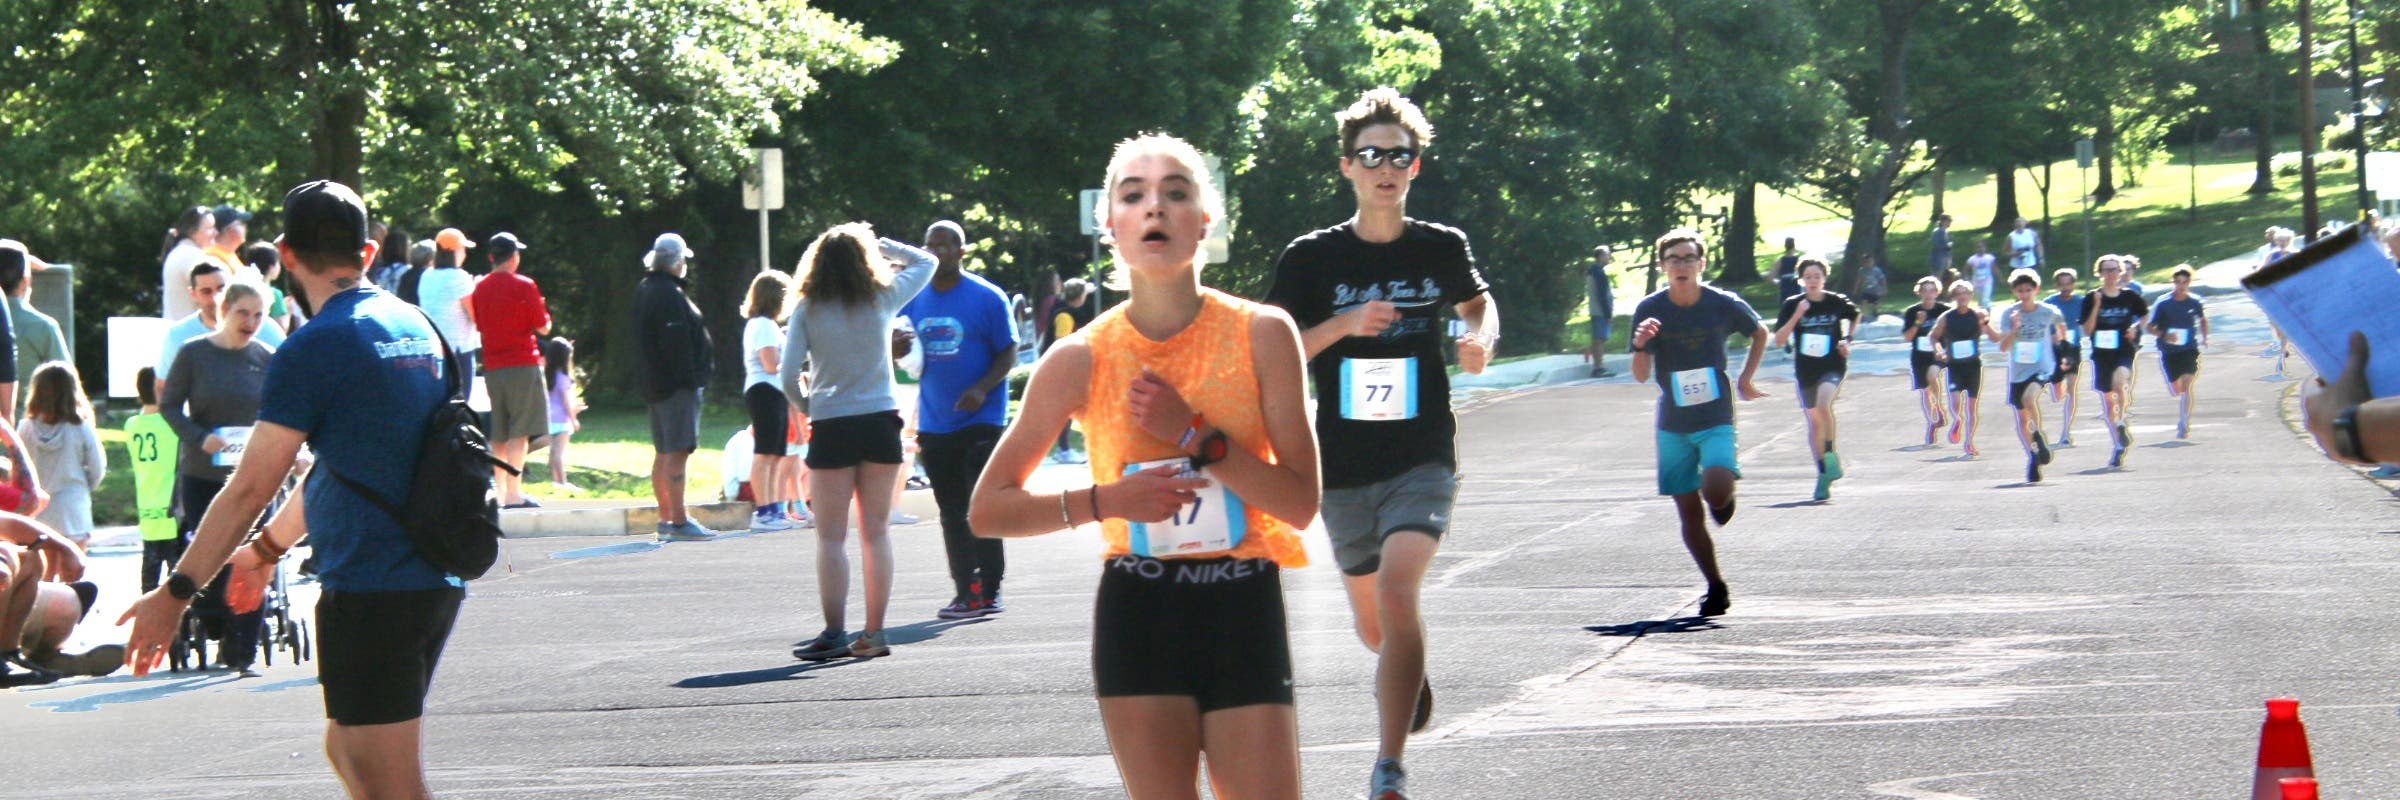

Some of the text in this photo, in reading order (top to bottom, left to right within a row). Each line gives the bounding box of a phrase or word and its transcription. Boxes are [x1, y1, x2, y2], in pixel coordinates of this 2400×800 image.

[1364, 384, 1394, 402] 77
[1682, 382, 1707, 396] 657
[133, 432, 158, 461] 23
[1111, 555, 1164, 579] RO
[1174, 560, 1253, 584] NIKE
